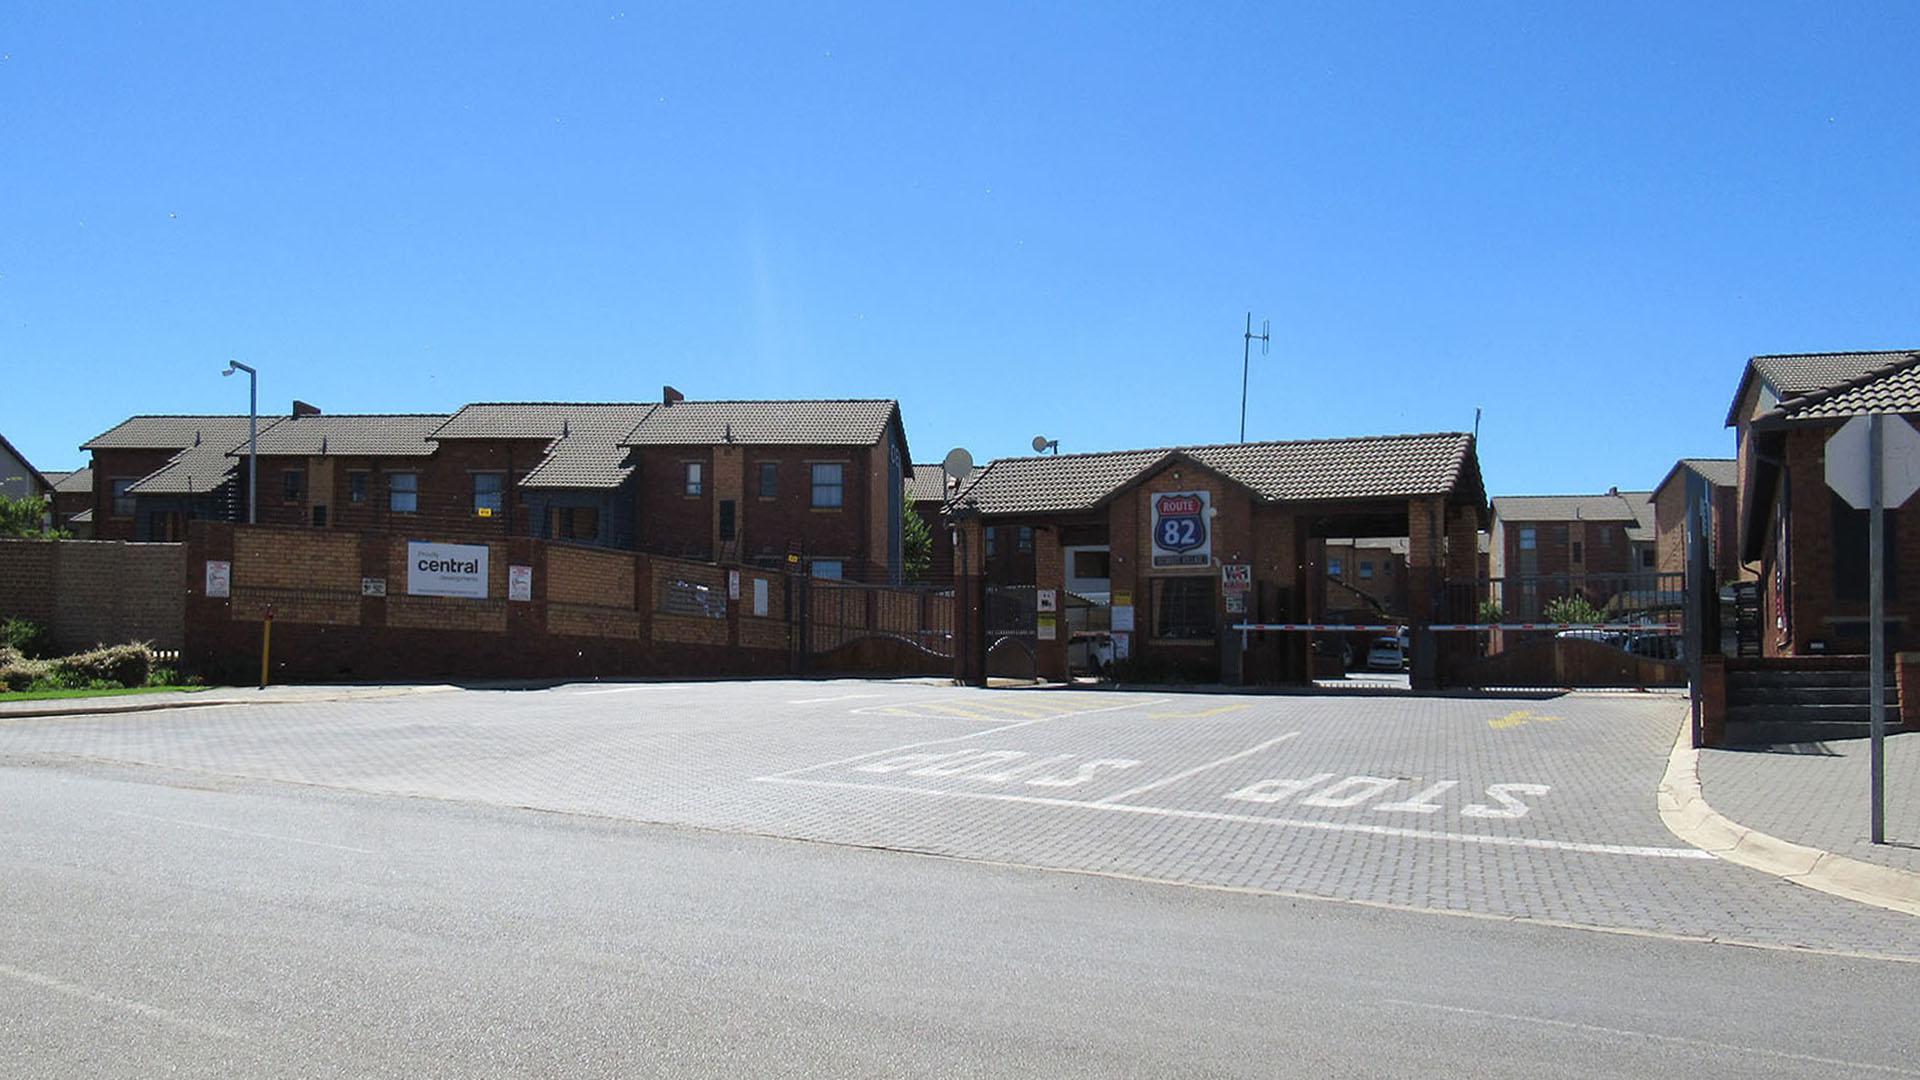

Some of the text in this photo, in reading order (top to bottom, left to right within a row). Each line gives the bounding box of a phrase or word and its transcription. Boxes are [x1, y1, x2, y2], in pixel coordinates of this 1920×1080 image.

[1163, 500, 1195, 512] ROUTE
[1164, 520, 1196, 545] 82
[417, 558, 479, 574] central
[854, 749, 1142, 787] STOP
[1224, 773, 1551, 818] STOP
